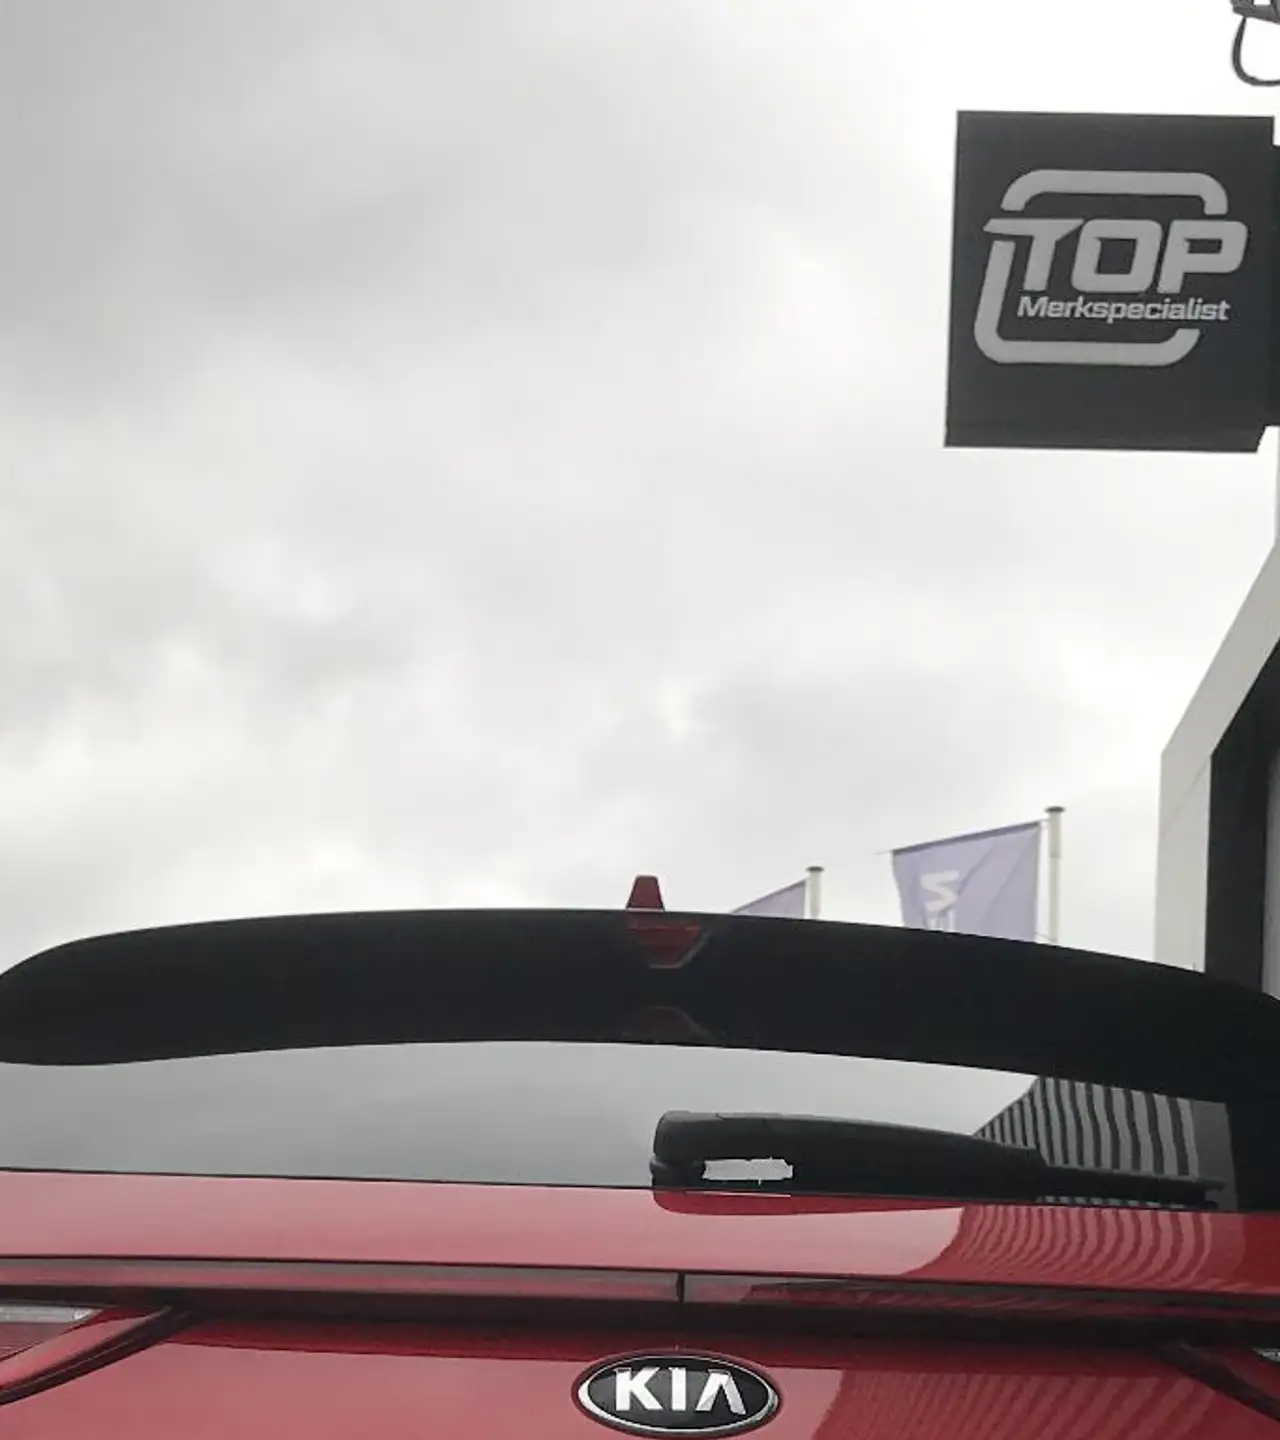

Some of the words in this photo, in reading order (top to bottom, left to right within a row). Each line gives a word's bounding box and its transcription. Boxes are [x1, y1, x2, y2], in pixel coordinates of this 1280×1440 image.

[982, 217, 1249, 294] TOP
[1017, 295, 1231, 324] Merkspecialist
[613, 1366, 747, 1415] KIA
